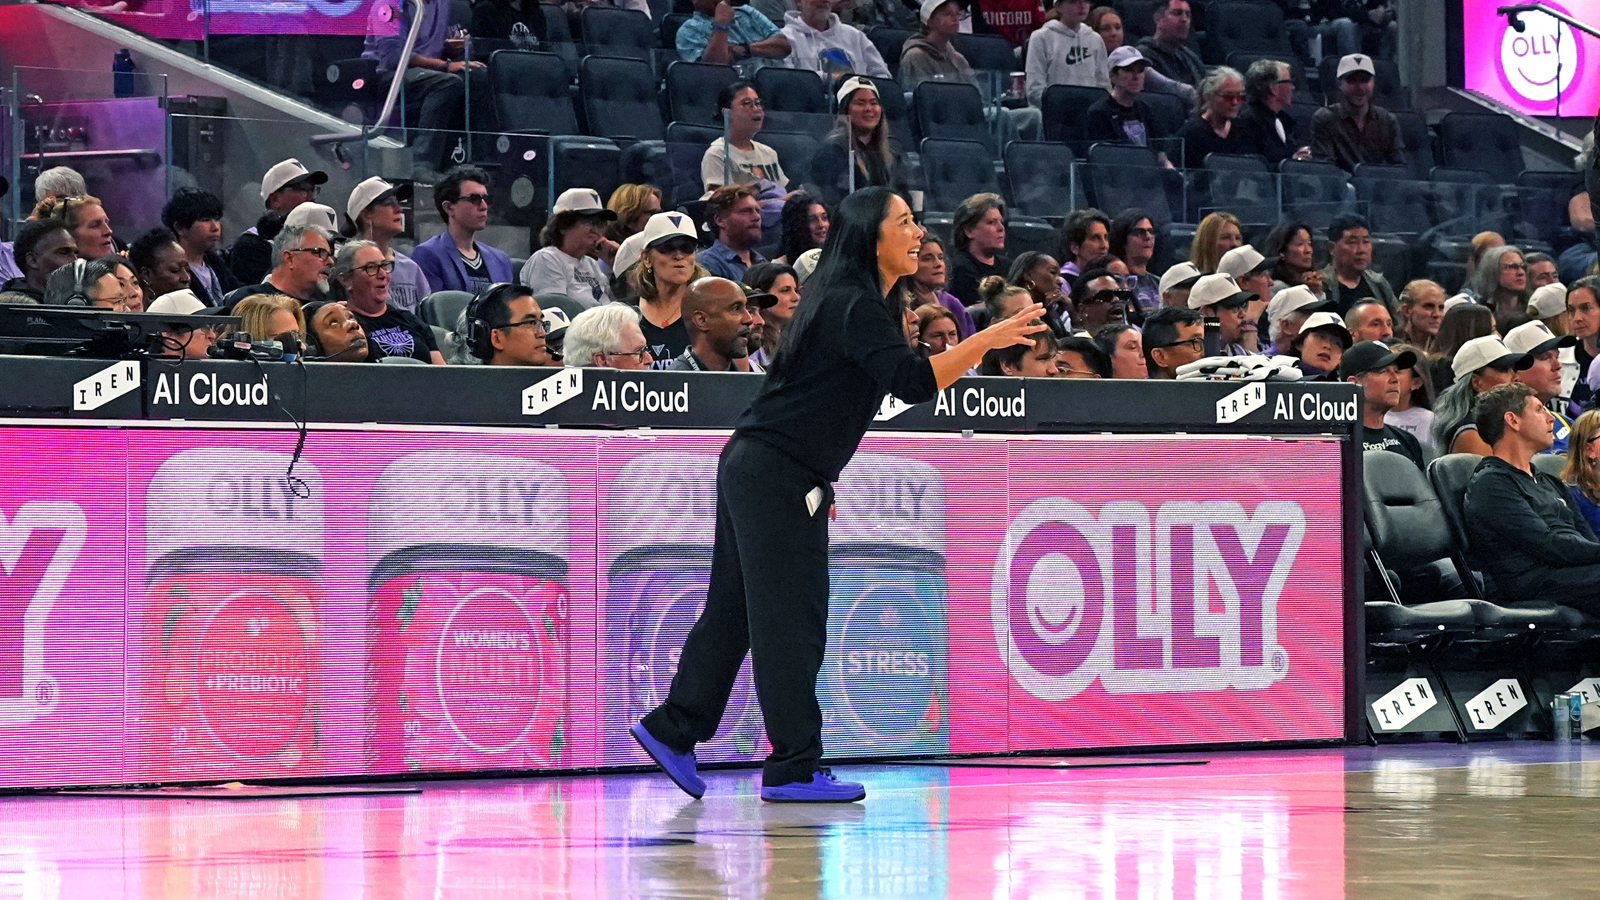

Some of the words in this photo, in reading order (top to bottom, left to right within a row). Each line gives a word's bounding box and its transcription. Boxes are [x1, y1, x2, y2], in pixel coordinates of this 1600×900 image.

[1512, 34, 1560, 57] OLLY
[80, 367, 134, 404] IREN
[153, 373, 180, 405] AI
[189, 373, 269, 405] Cloud
[527, 374, 577, 409] IREN
[592, 381, 617, 411] AI
[621, 381, 689, 412] Cloud
[934, 388, 956, 416] AI
[963, 388, 1026, 417] Cloud
[1221, 387, 1261, 418] IREN
[1273, 393, 1294, 420] AI
[1300, 393, 1358, 421] Cloud
[206, 470, 299, 522] OLLY
[438, 473, 541, 526] OLLY
[849, 477, 928, 520] OLLY
[1006, 518, 1294, 680] OLLY
[453, 629, 531, 651] WOMEN'S
[202, 649, 306, 673] PROBIOTIC
[450, 652, 533, 685] MULTI
[847, 650, 930, 678] STRESS
[1380, 684, 1428, 724] IREN
[1473, 685, 1519, 724] IREN
[403, 719, 421, 738] 90
